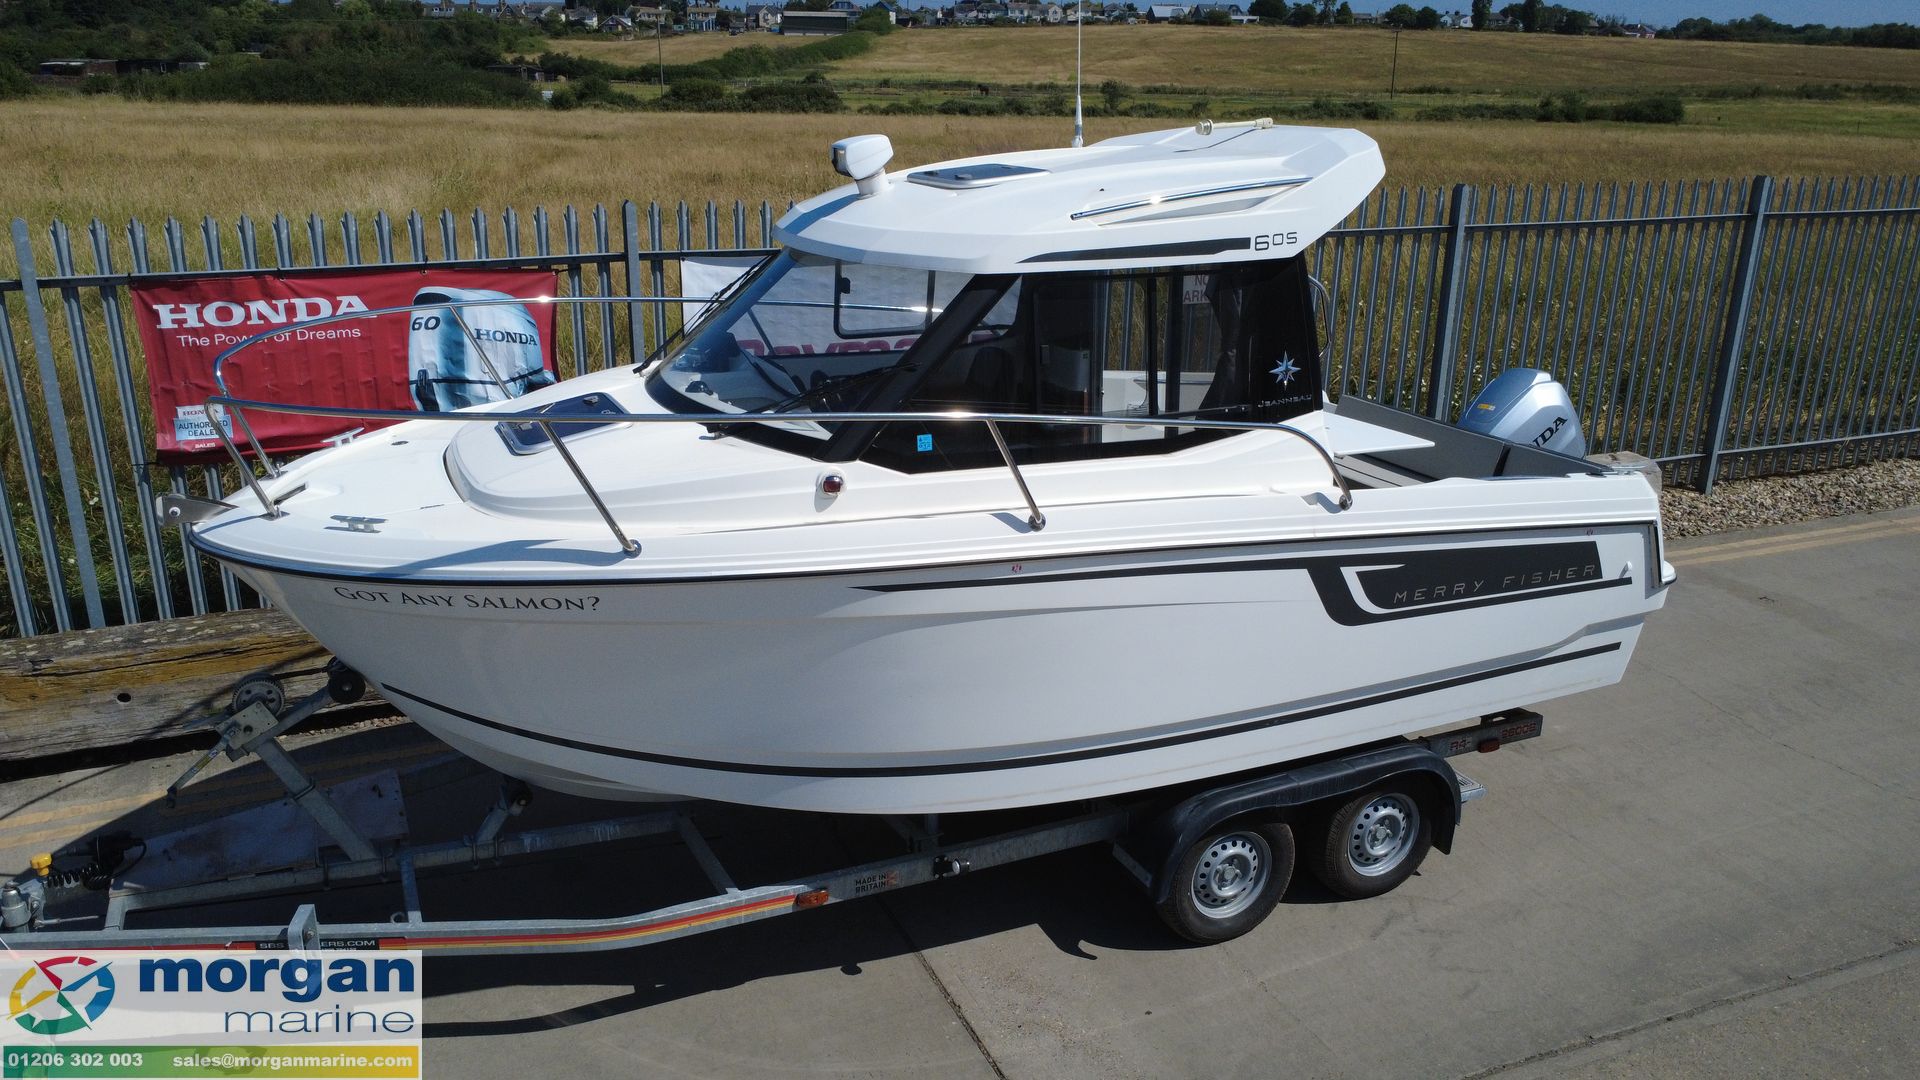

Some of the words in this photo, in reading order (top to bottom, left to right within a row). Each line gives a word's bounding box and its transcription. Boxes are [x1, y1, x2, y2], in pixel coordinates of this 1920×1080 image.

[153, 295, 377, 329] HONDA
[411, 316, 441, 331] 60
[176, 334, 210, 348] The
[296, 327, 362, 341] Dreams
[474, 328, 538, 346] HONDA
[1257, 394, 1313, 408] JEANNEAU
[1393, 579, 1485, 604] MERRY
[1502, 564, 1597, 589] FISHER
[401, 591, 453, 607] ANY
[855, 875, 877, 886] MADE
[878, 872, 887, 880] IN
[855, 880, 886, 894] BRITAIN
